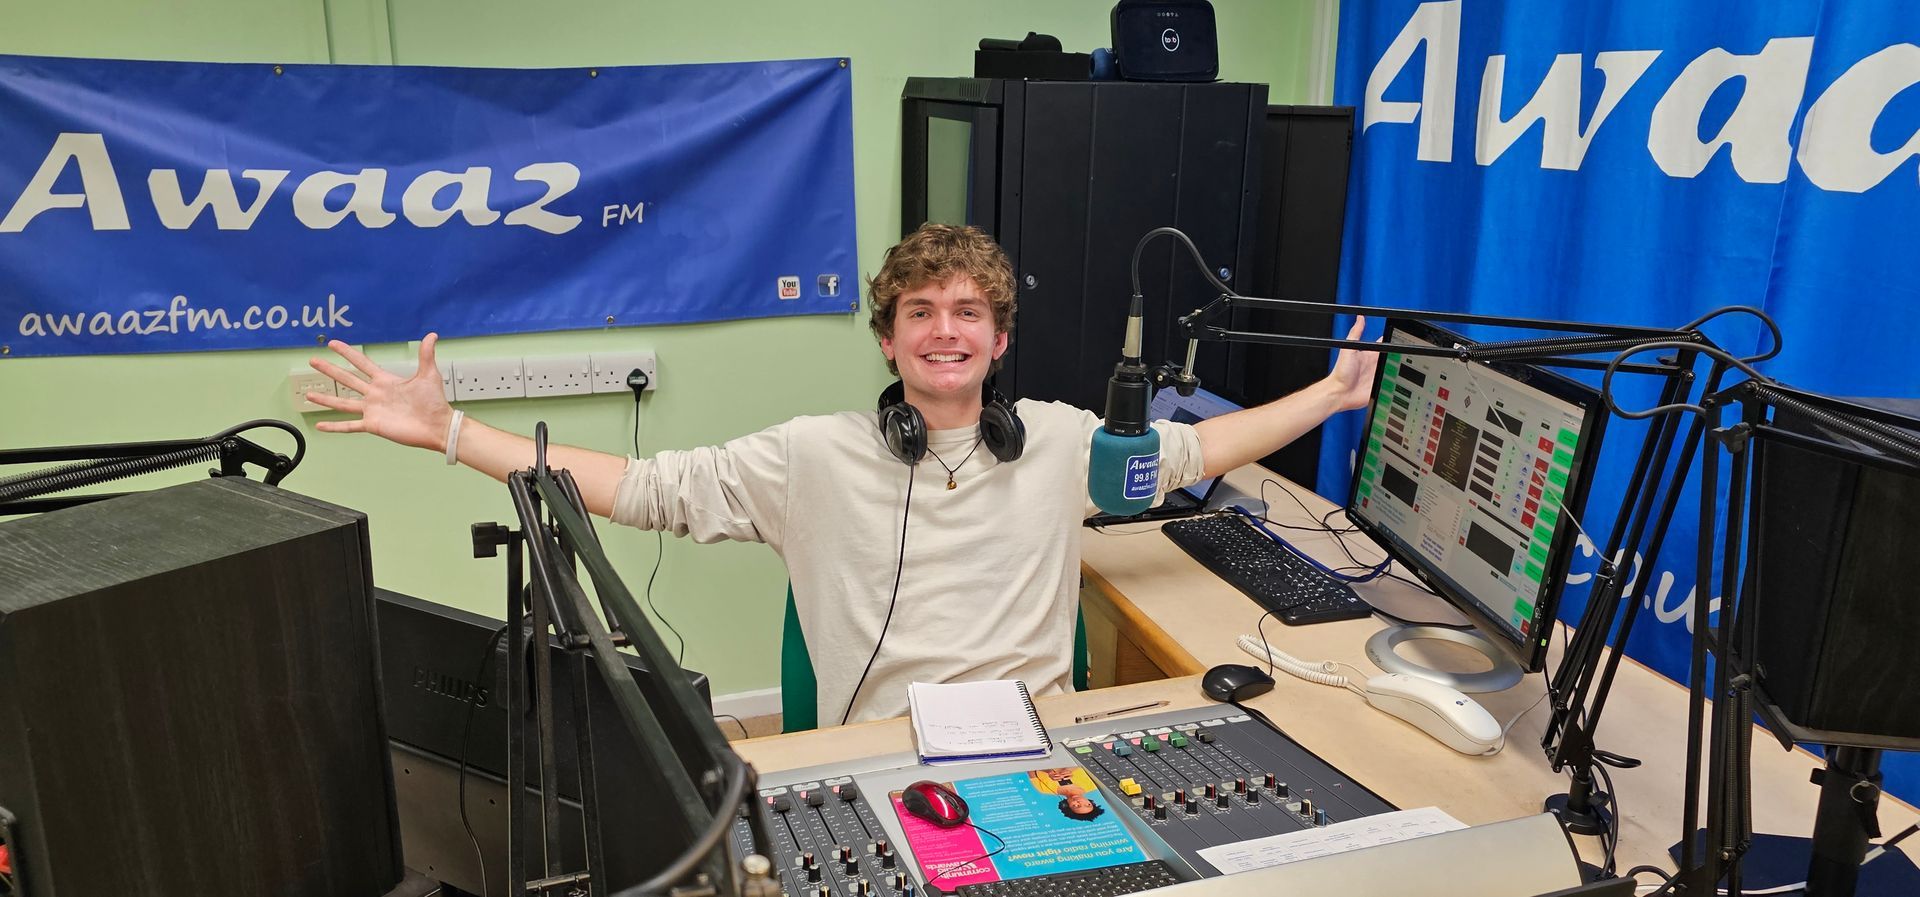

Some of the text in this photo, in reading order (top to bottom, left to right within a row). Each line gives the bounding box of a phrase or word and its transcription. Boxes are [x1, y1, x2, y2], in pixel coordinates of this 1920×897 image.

[0, 132, 645, 235] Awaaz FM
[782, 279, 797, 288] You
[19, 294, 354, 336] awaazfm.co.uk
[1134, 472, 1150, 483] 99.8
[412, 665, 490, 708] PHILIPS
[1008, 838, 1129, 862] winning radio right now?
[1095, 848, 1115, 858] you
[1116, 846, 1134, 854] Are
[1057, 852, 1094, 863] making
[925, 861, 962, 871] awards
[938, 867, 991, 880] community
